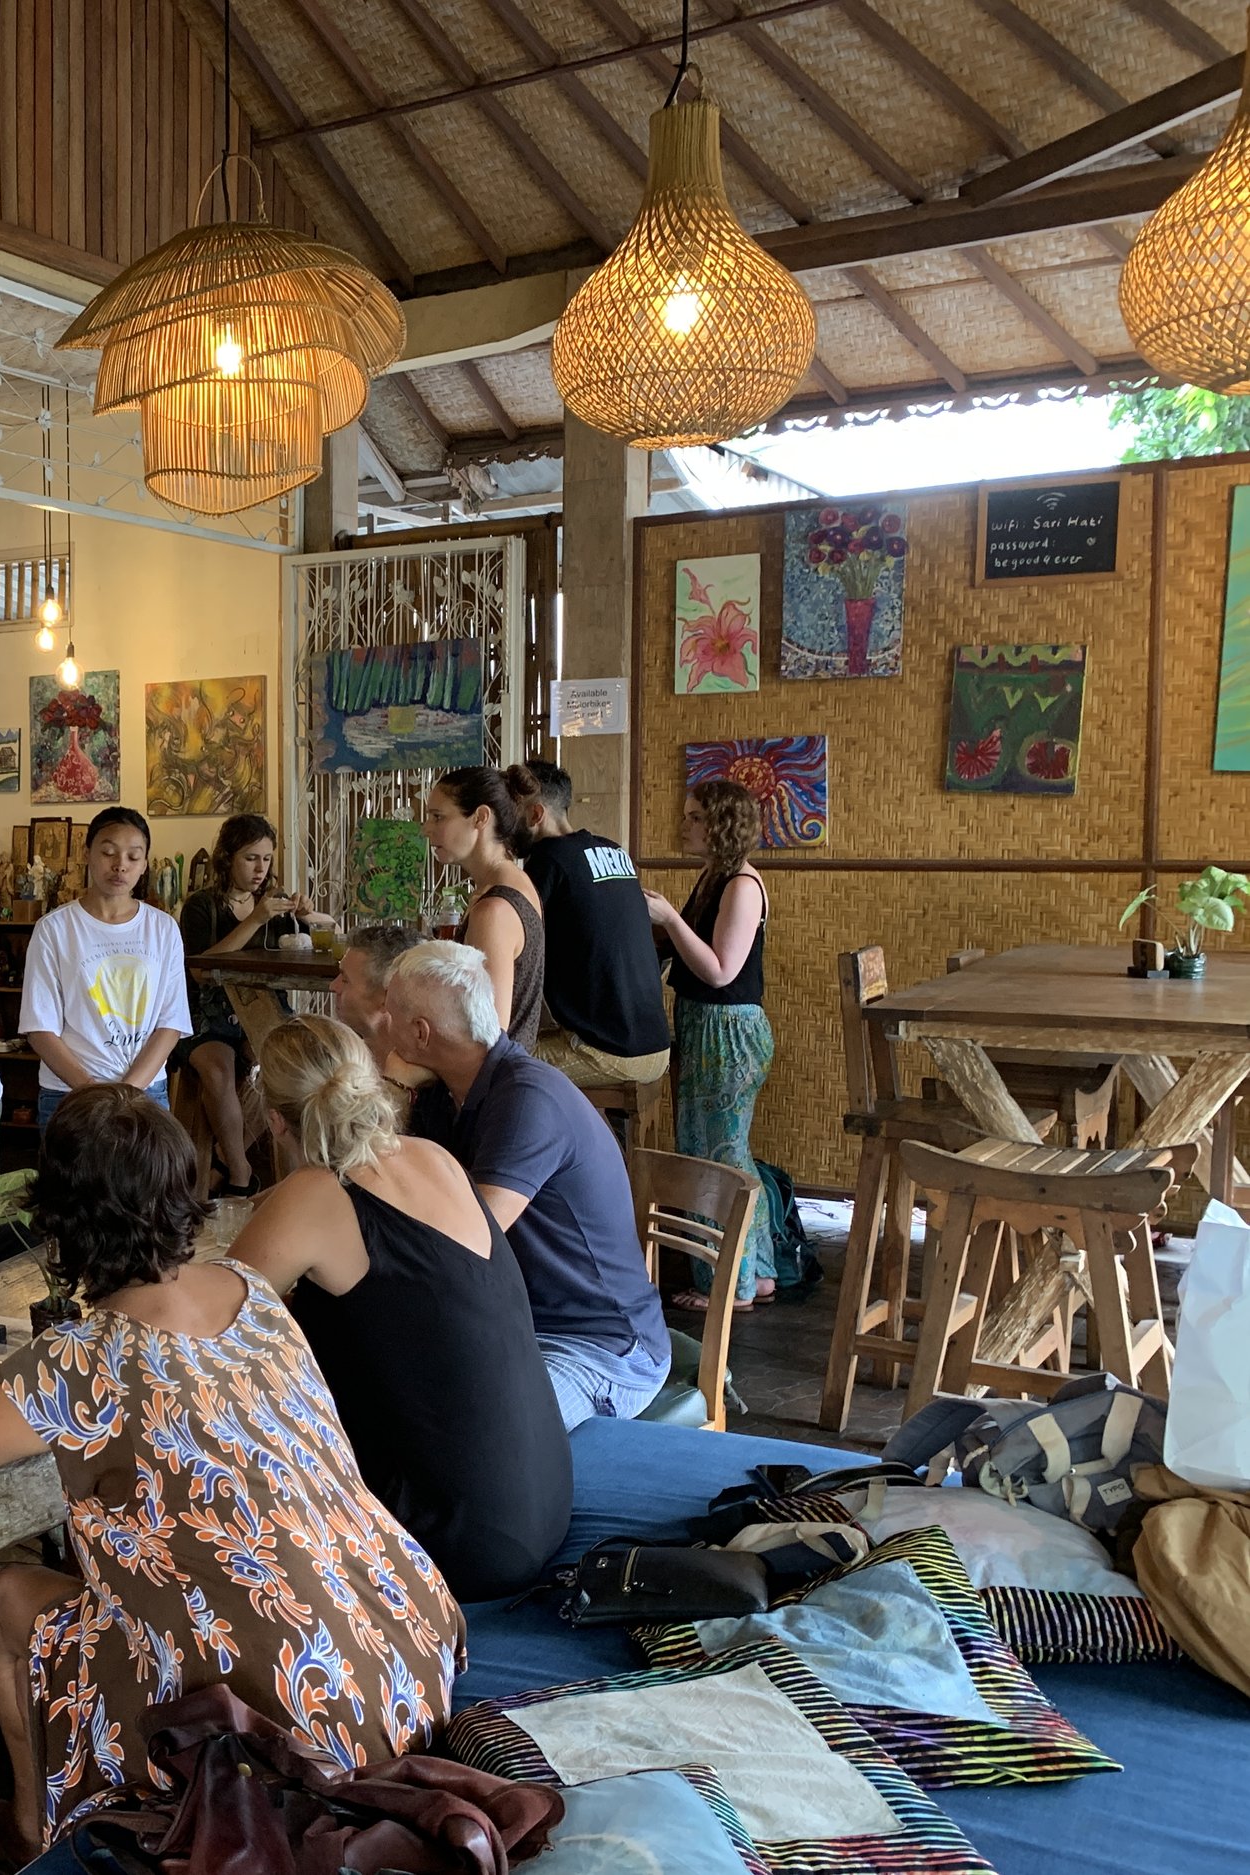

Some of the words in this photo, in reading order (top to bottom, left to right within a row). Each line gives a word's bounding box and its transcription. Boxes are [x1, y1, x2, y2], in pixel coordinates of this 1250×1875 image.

[1033, 516, 1062, 529] Sari
[570, 689, 608, 699] Available
[80, 947, 119, 968] PREMIUM
[1102, 1483, 1125, 1495] TYPO
